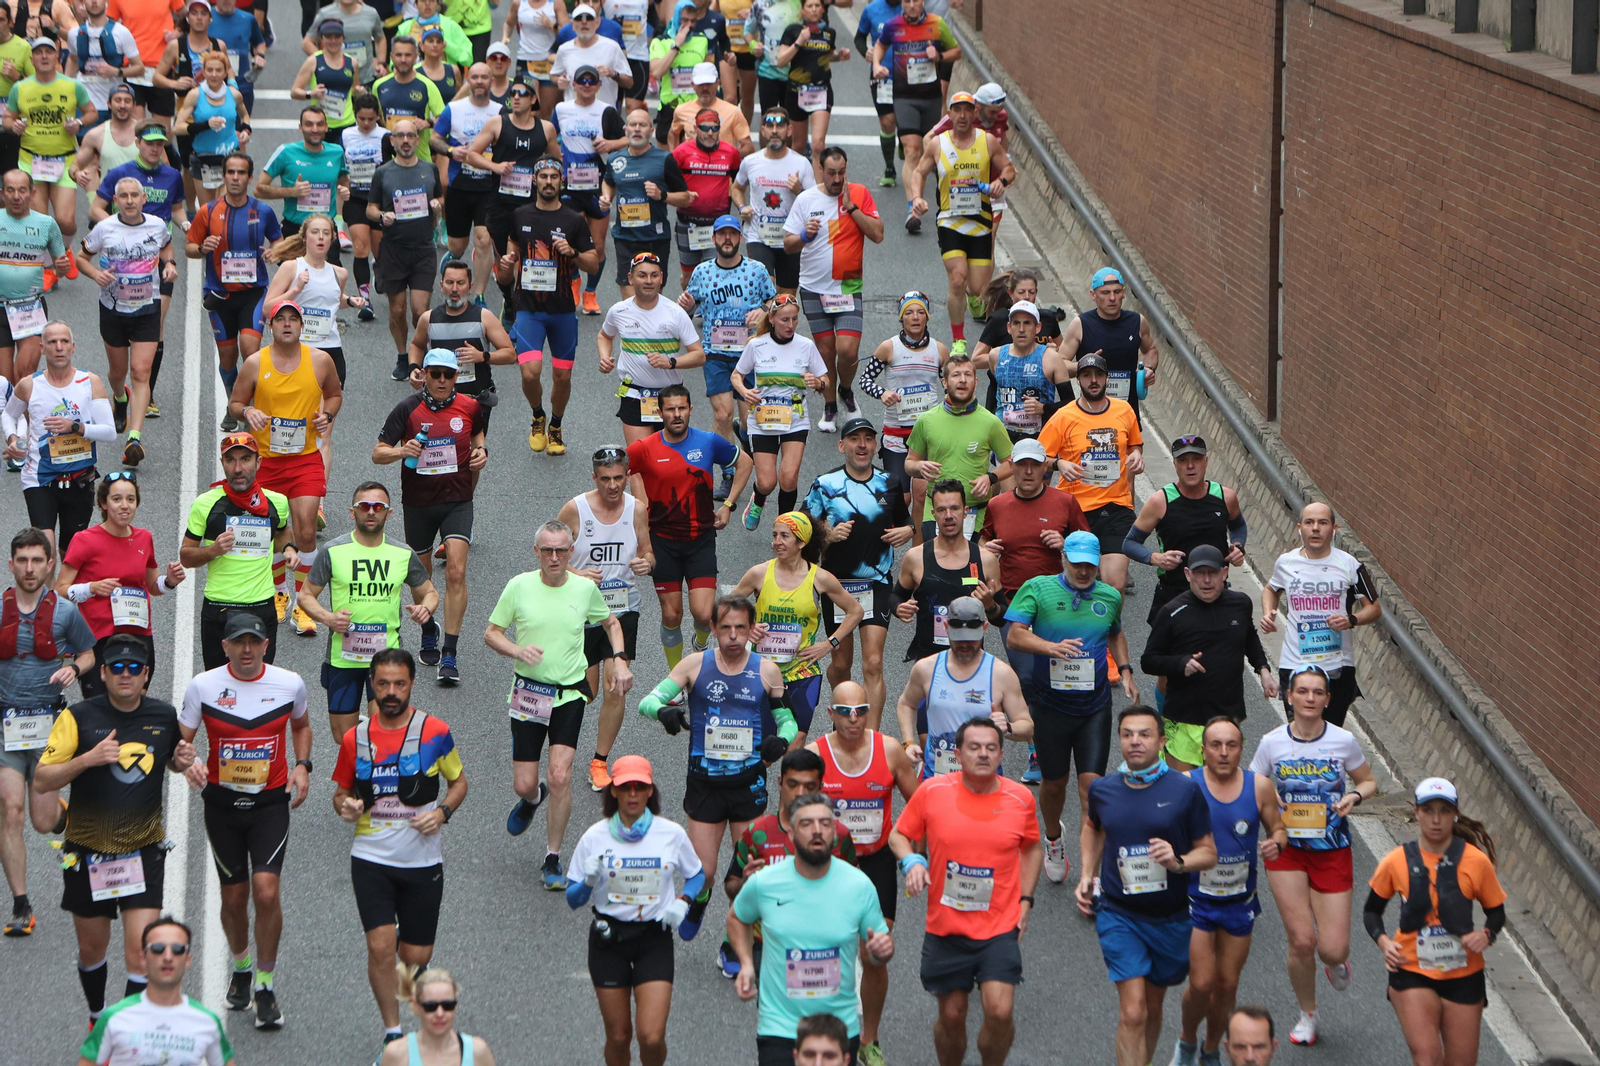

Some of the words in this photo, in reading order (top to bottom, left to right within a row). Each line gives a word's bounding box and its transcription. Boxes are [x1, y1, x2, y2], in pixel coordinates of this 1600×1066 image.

[710, 284, 744, 306] COMO
[306, 308, 328, 316] ZURICH
[1024, 364, 1038, 372] RC
[428, 438, 452, 447] ZURICH
[241, 517, 267, 526] ZURICH
[352, 560, 391, 582] FW
[350, 583, 394, 596] FLOW
[600, 581, 624, 589] ZURICH
[845, 584, 868, 592] ZURICH
[124, 588, 146, 598] ZURICH
[768, 604, 795, 614] RUNNERS
[1312, 635, 1330, 644] 12004
[1064, 664, 1080, 672] 8439
[526, 685, 552, 695] ZURICH
[850, 801, 878, 809] ZURICH
[1130, 846, 1150, 856] ZURI
[626, 859, 656, 868] ZURICH
[961, 868, 990, 877] ZURICH
[805, 950, 834, 960] ZURICH
